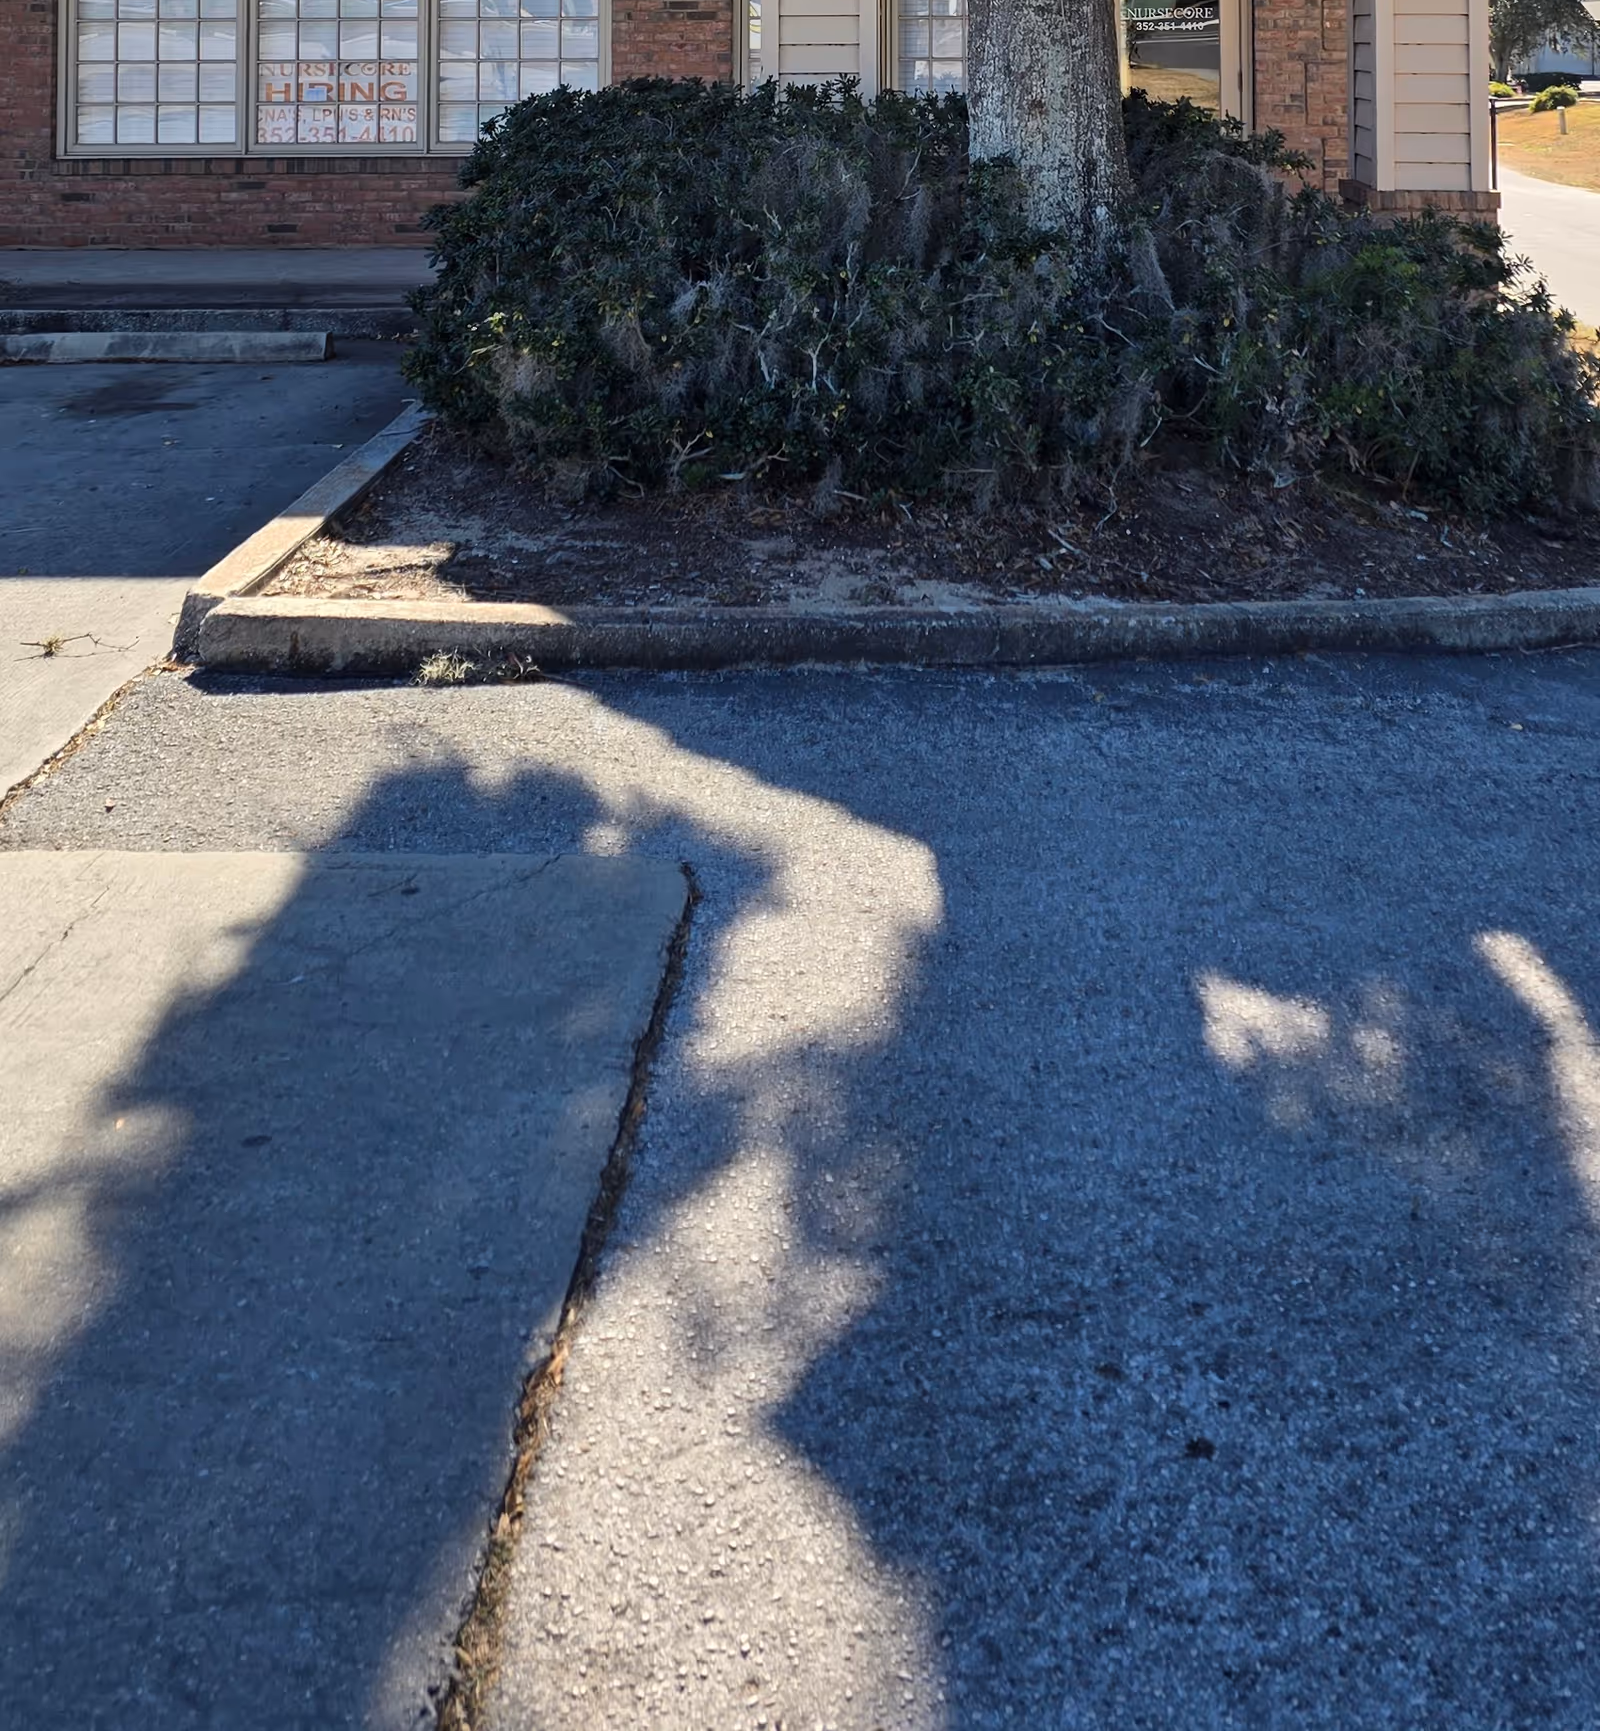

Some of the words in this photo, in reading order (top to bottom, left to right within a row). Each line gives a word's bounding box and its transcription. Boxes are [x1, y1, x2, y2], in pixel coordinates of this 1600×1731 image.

[1126, 7, 1214, 19] NURSECORE
[265, 81, 408, 102] HIRING
[364, 108, 374, 121] &
[380, 108, 416, 122] RN'S
